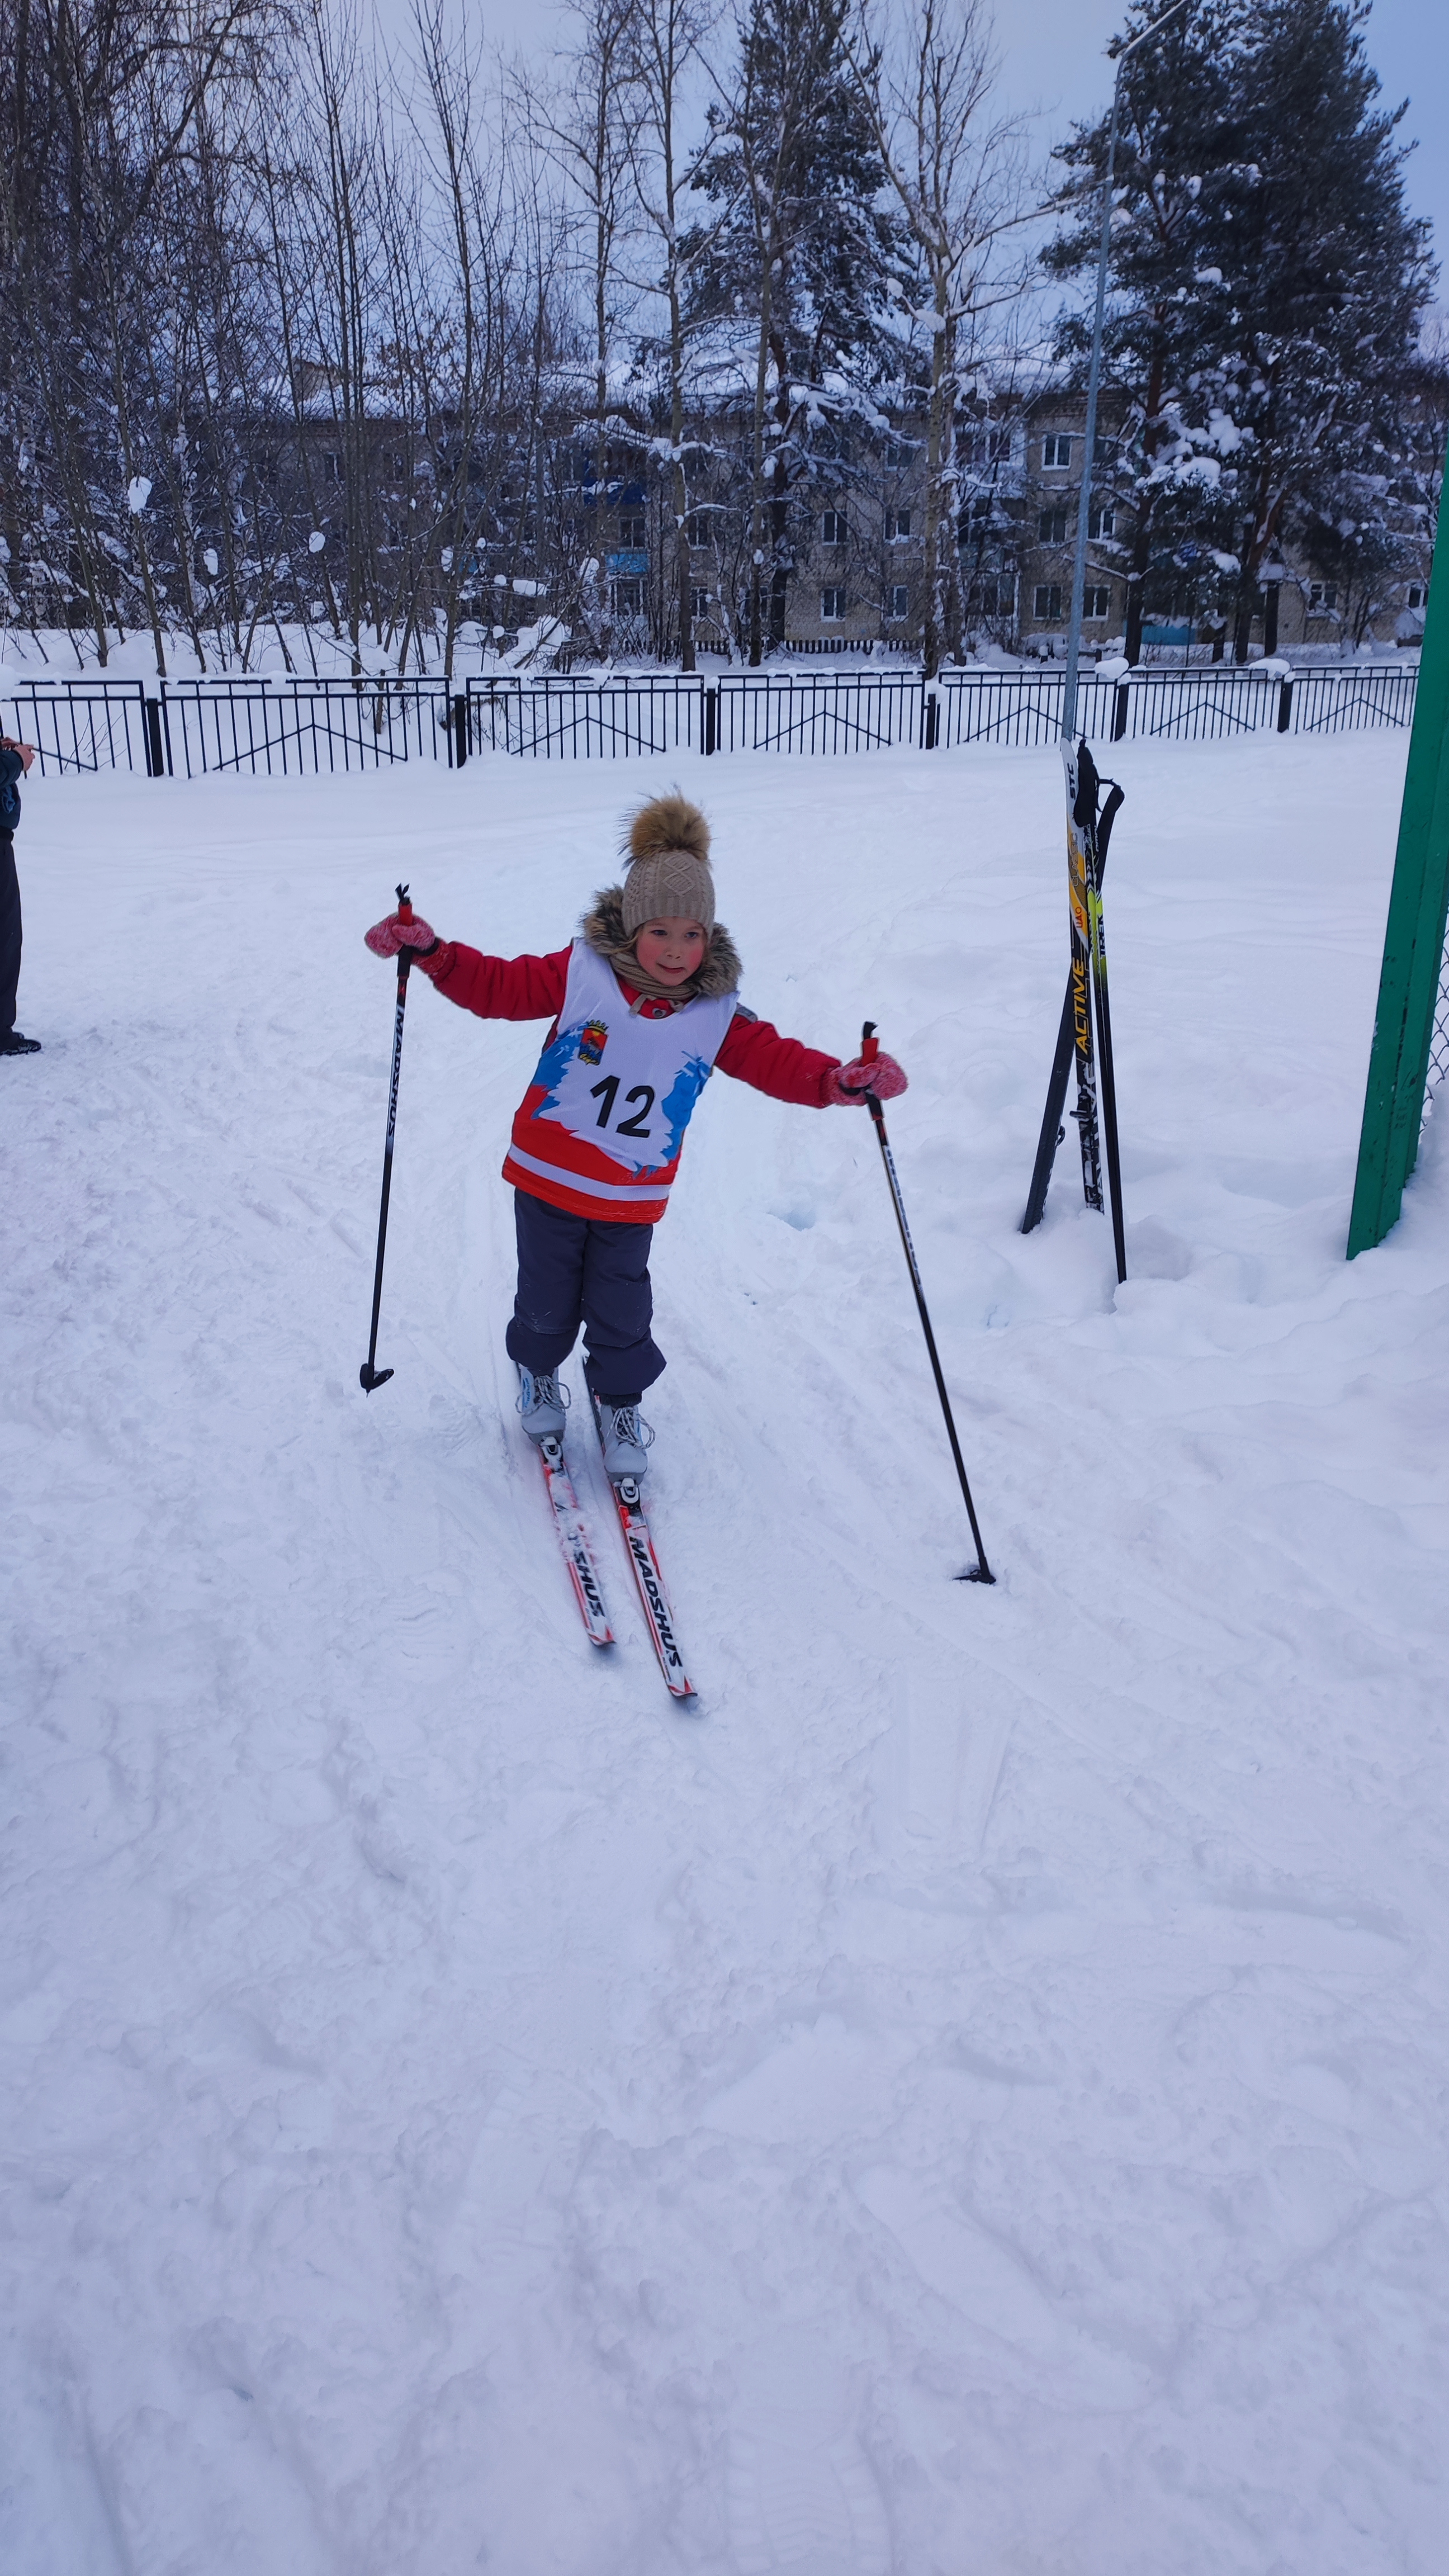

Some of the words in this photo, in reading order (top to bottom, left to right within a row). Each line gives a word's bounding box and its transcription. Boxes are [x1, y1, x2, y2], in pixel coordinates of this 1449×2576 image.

[1067, 763, 1076, 801] STC
[1069, 832, 1079, 887] CLASSIC
[1097, 913, 1106, 958] TREK
[1072, 956, 1088, 1055] ACTIVE
[388, 1010, 404, 1138] MADSHUS
[589, 1074, 655, 1138] 12
[628, 1534, 683, 1668] MADSHUS
